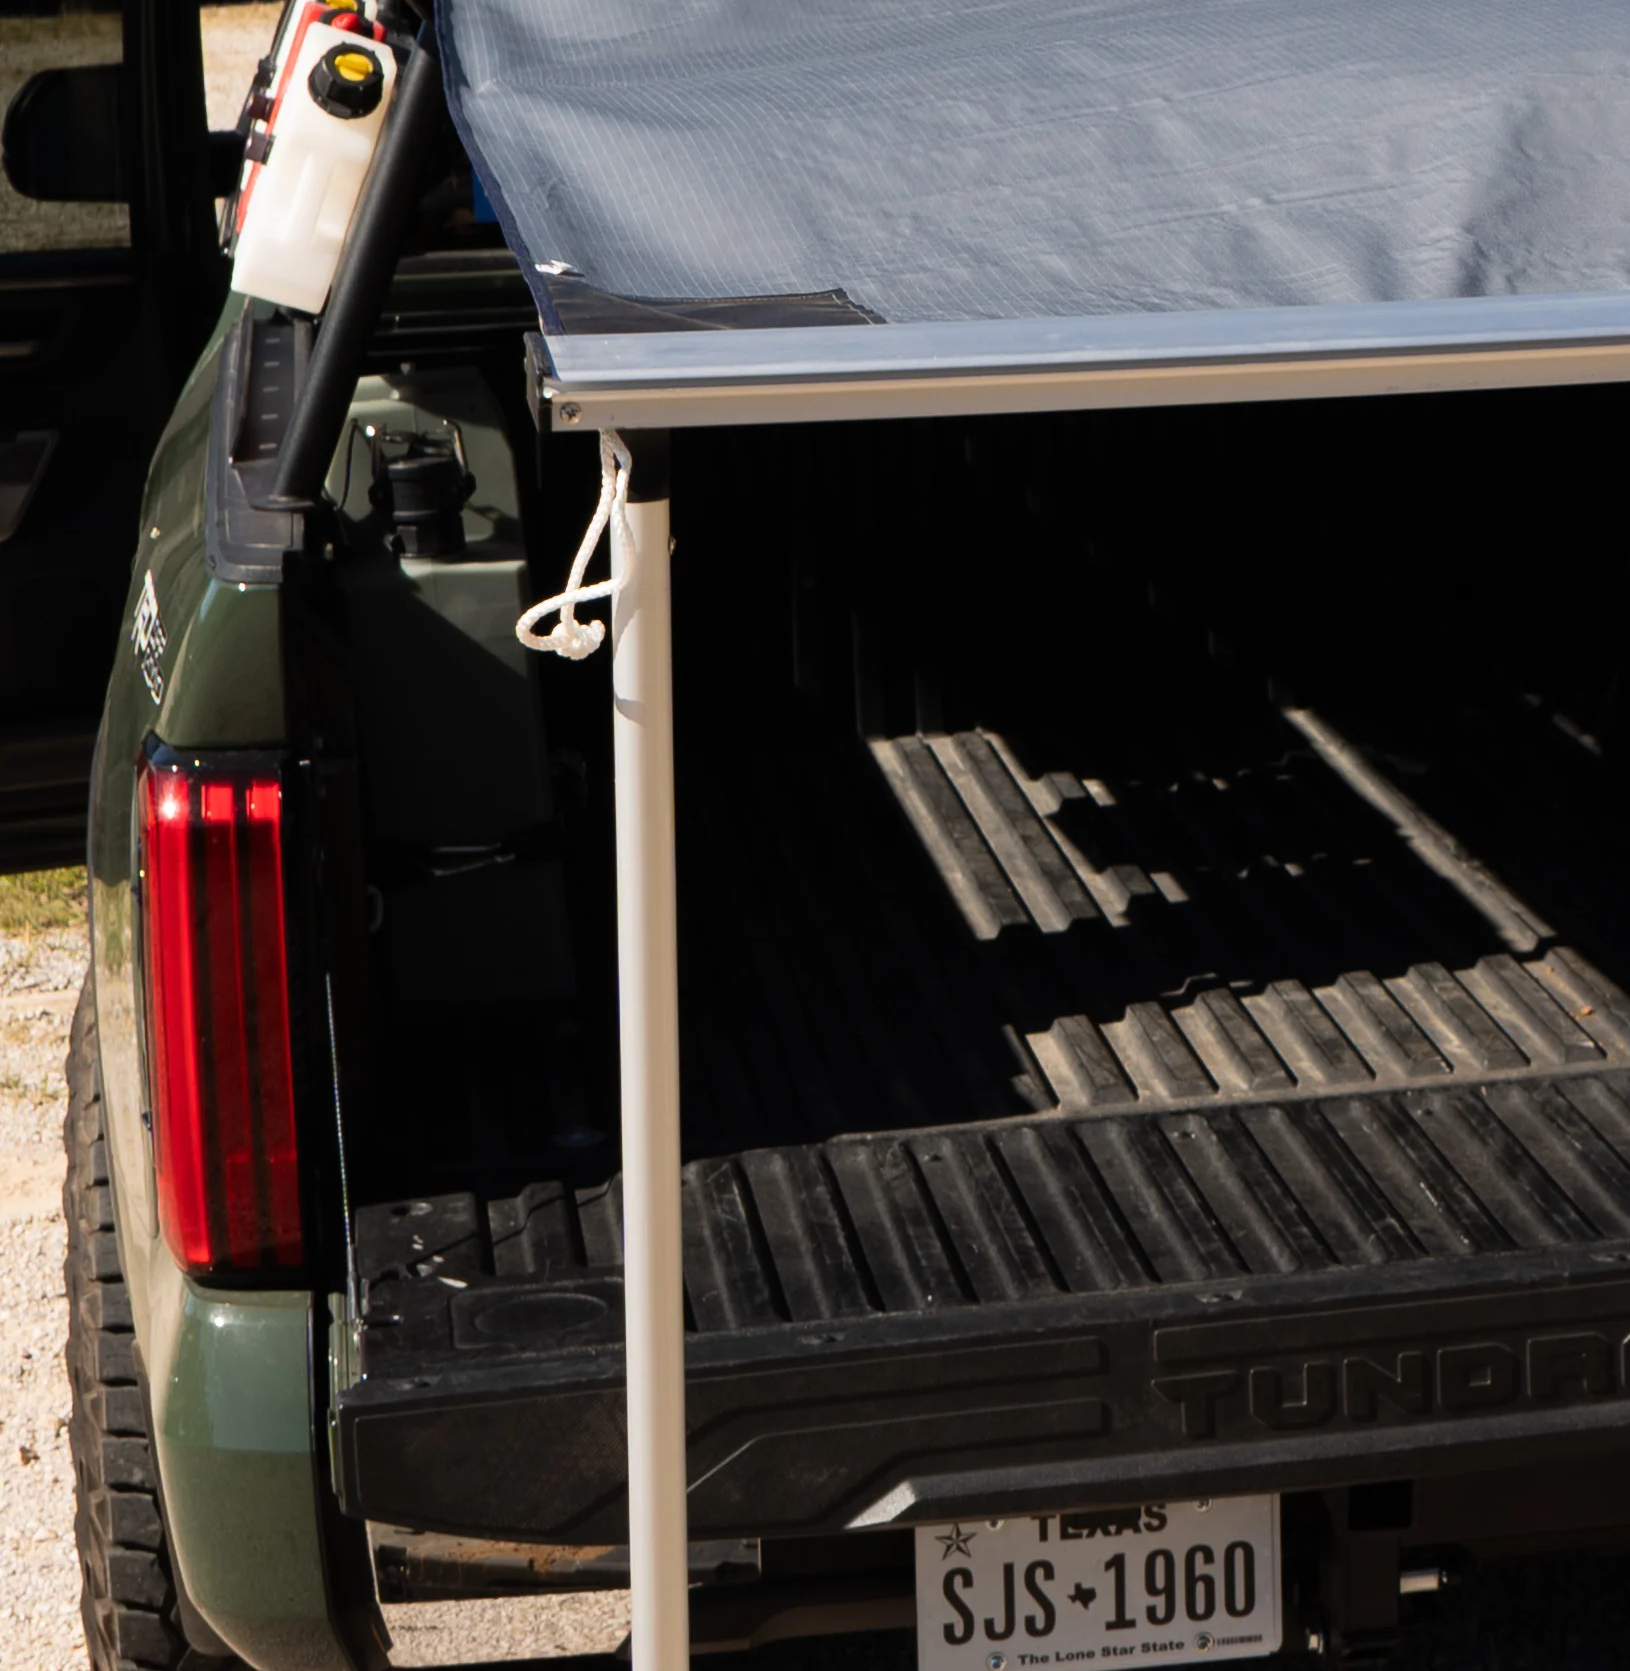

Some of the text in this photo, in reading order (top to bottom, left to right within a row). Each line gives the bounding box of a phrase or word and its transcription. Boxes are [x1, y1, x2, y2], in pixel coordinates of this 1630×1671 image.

[942, 1540, 1256, 1646] SJS 1960
[1017, 1640, 1185, 1666] The Lone Star State
